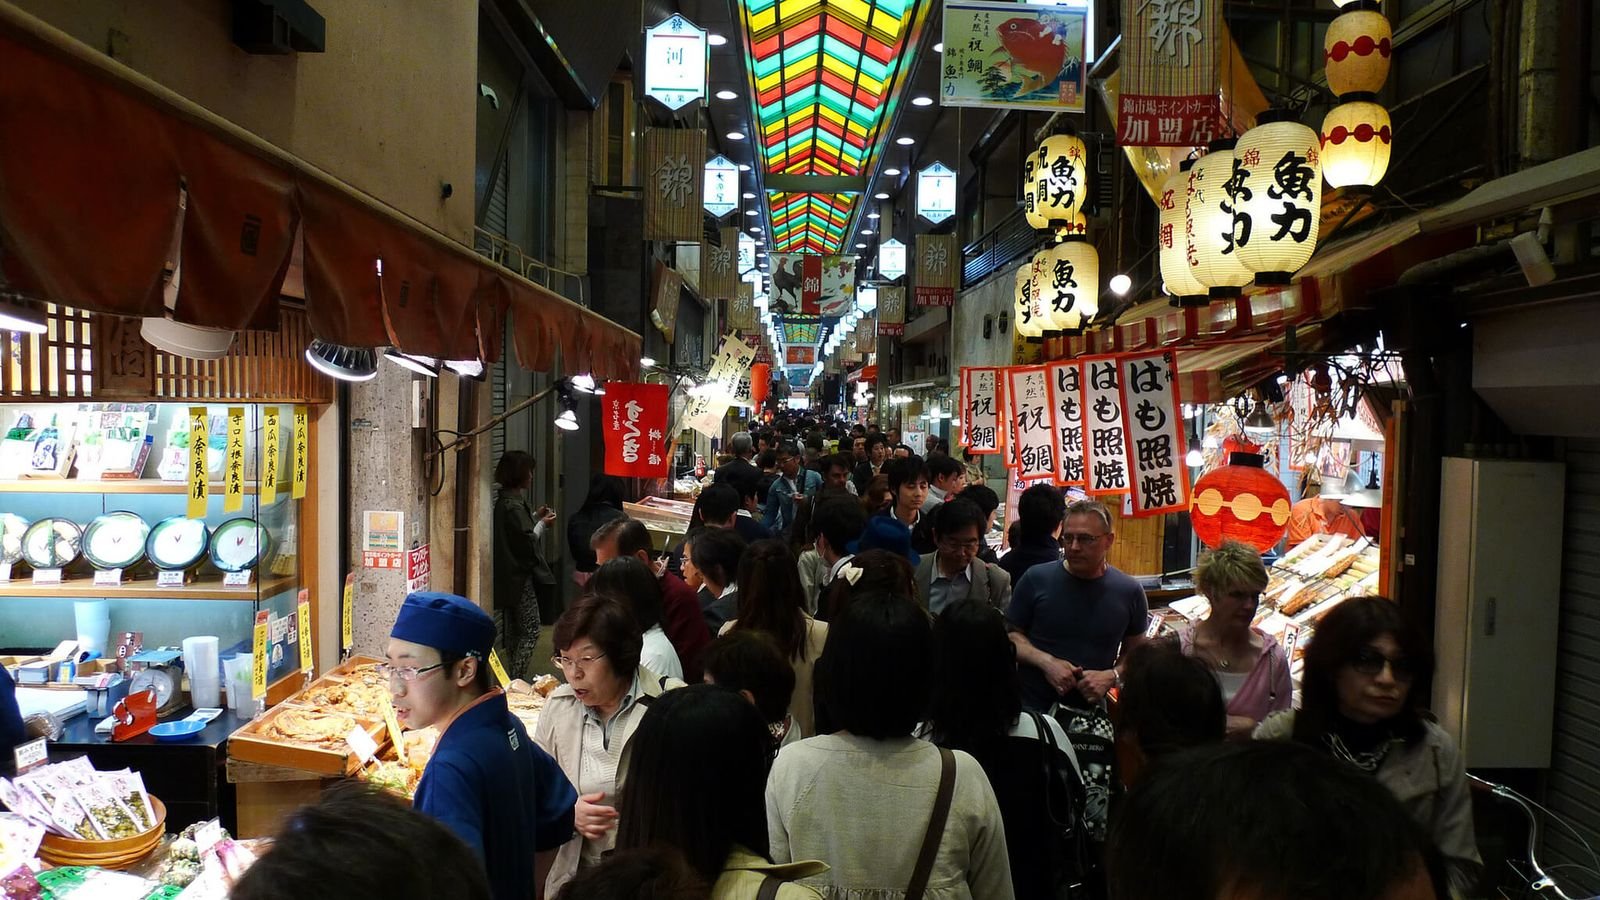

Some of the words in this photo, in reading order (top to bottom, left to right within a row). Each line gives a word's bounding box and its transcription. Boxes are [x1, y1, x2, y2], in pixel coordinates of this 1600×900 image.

[944, 47, 958, 97] 錦魚力
[1122, 98, 1217, 116] 錦市場ポイントカード
[1122, 115, 1216, 144] 加盟店
[1049, 155, 1077, 209] 魚力
[1242, 149, 1261, 168] 錦
[1267, 151, 1315, 243] 魚力
[1052, 258, 1078, 313] 魚力
[265, 415, 277, 488] 西瓜奈良漬
[971, 394, 997, 448] 祝鯛
[1017, 403, 1055, 475] 祝鯛
[1058, 366, 1085, 482] はも照焼
[1091, 361, 1125, 490] はも照焼
[1130, 360, 1177, 510] はも照焼
[229, 415, 242, 494] 守口大根奈良漬
